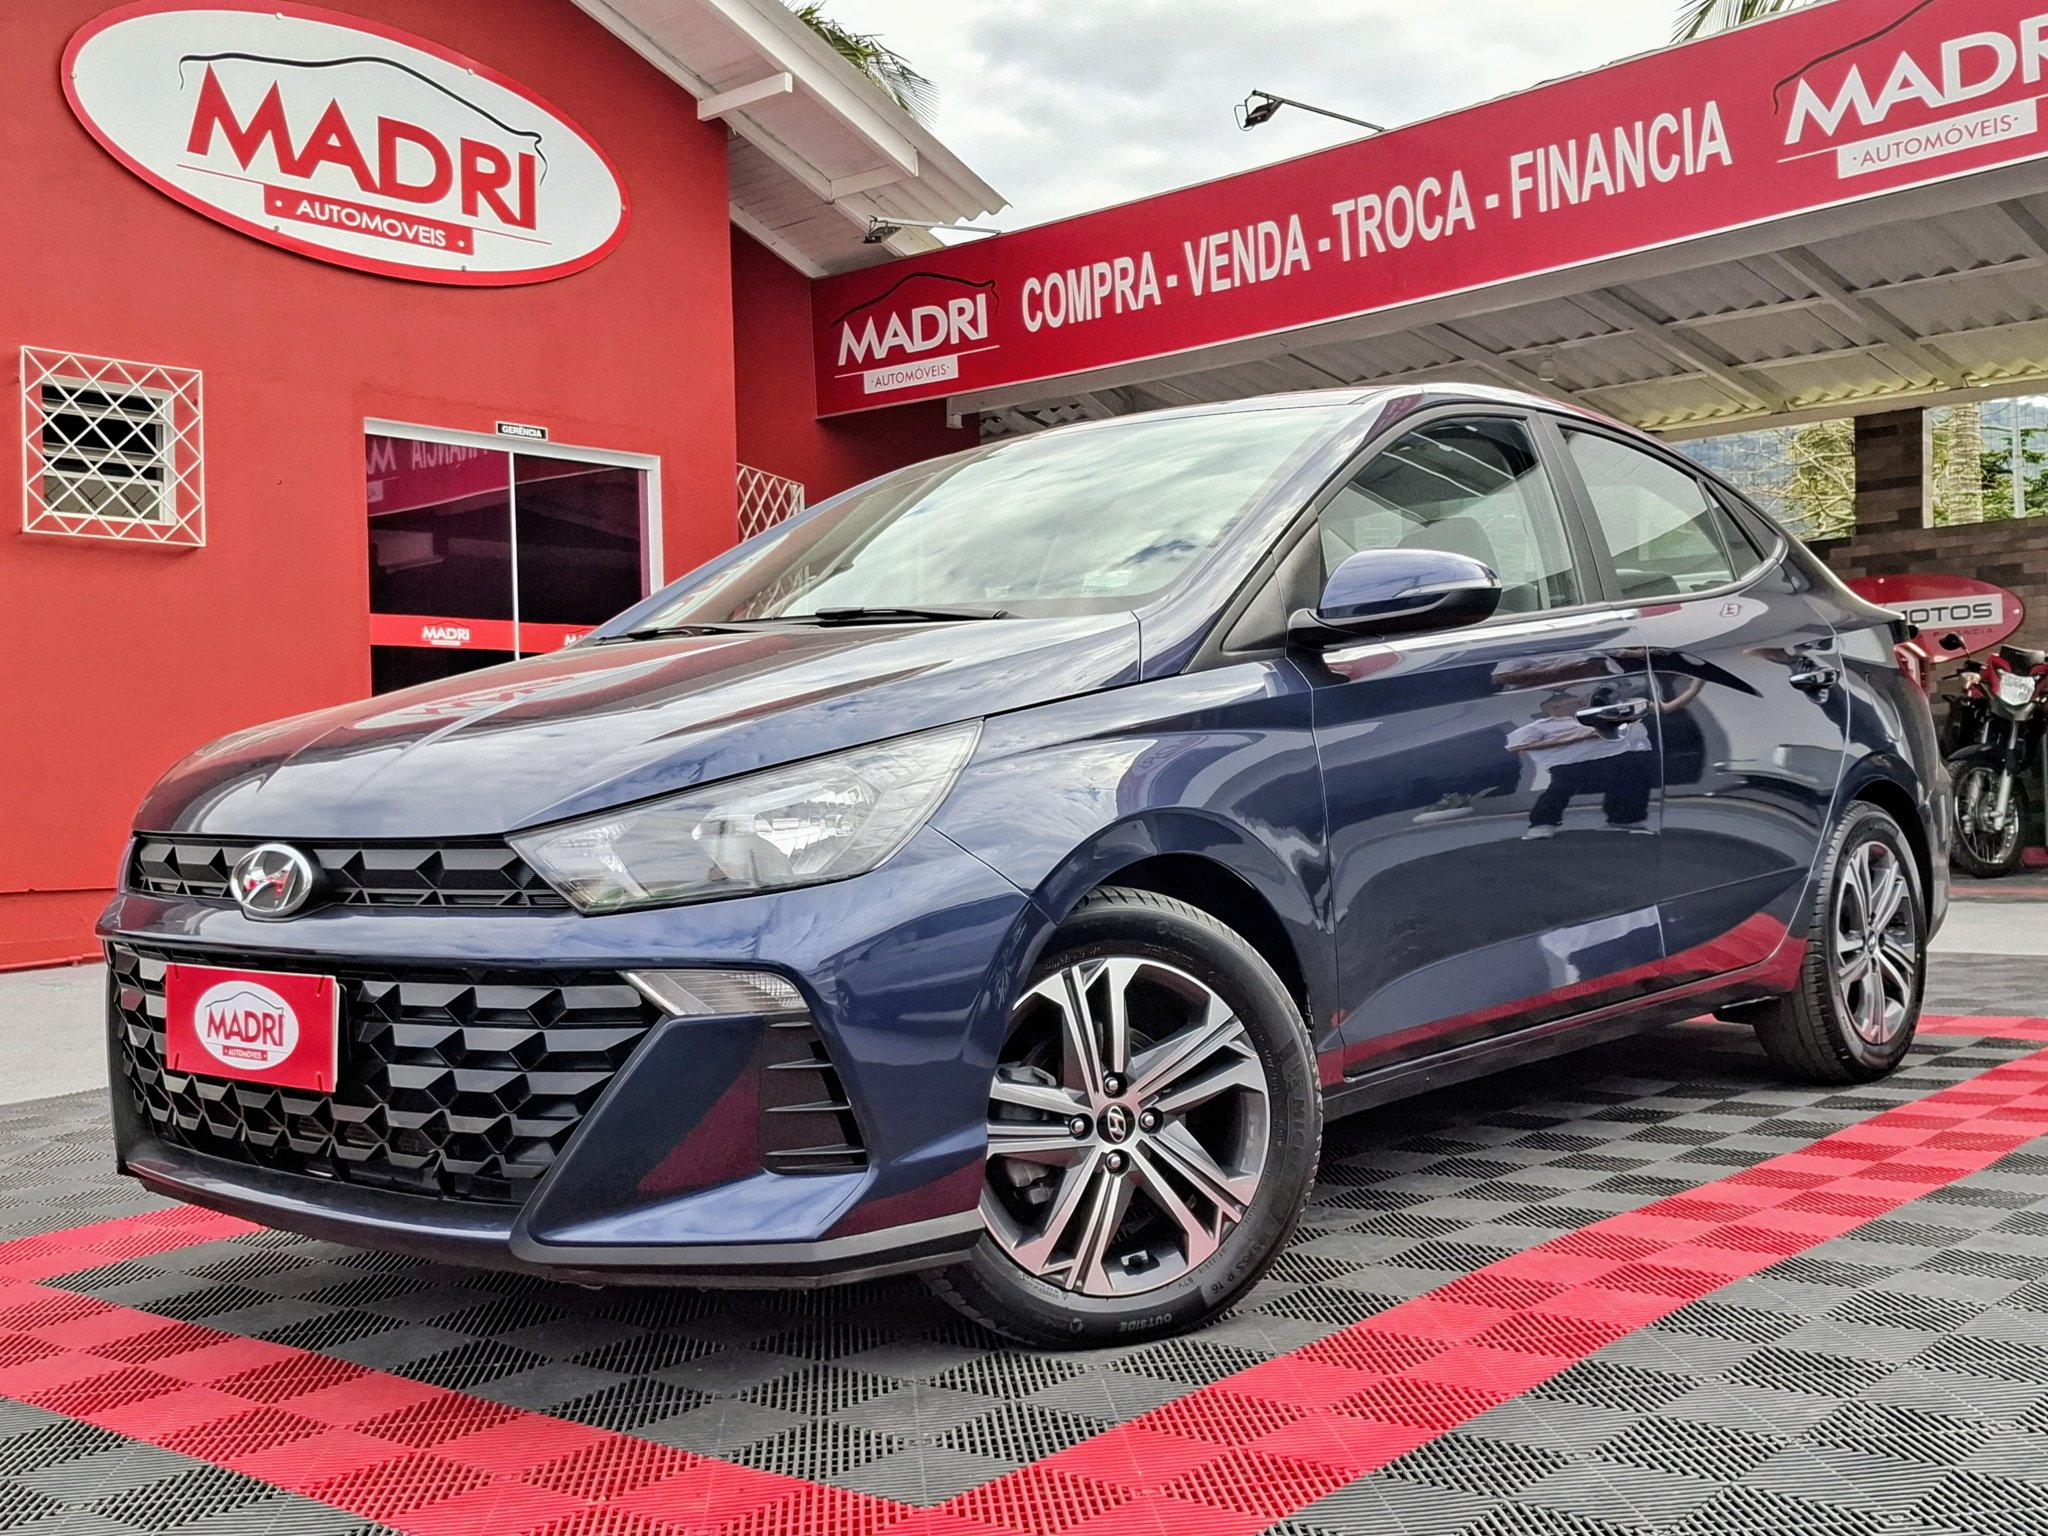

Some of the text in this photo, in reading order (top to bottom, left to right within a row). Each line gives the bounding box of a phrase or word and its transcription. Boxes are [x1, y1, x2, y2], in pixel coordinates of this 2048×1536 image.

[186, 62, 537, 231] MADRI
[1022, 251, 1162, 333] COMPRA
[1184, 214, 1311, 297] VENDA
[1332, 170, 1476, 262] TROCA
[1510, 100, 1733, 219] FINANCIA
[837, 293, 989, 367] MADRI
[501, 424, 543, 438] GERÊNCIA
[422, 626, 470, 641] MADRI
[207, 1006, 284, 1047] MADRI
[1119, 1313, 1173, 1331] OUTSIDE
